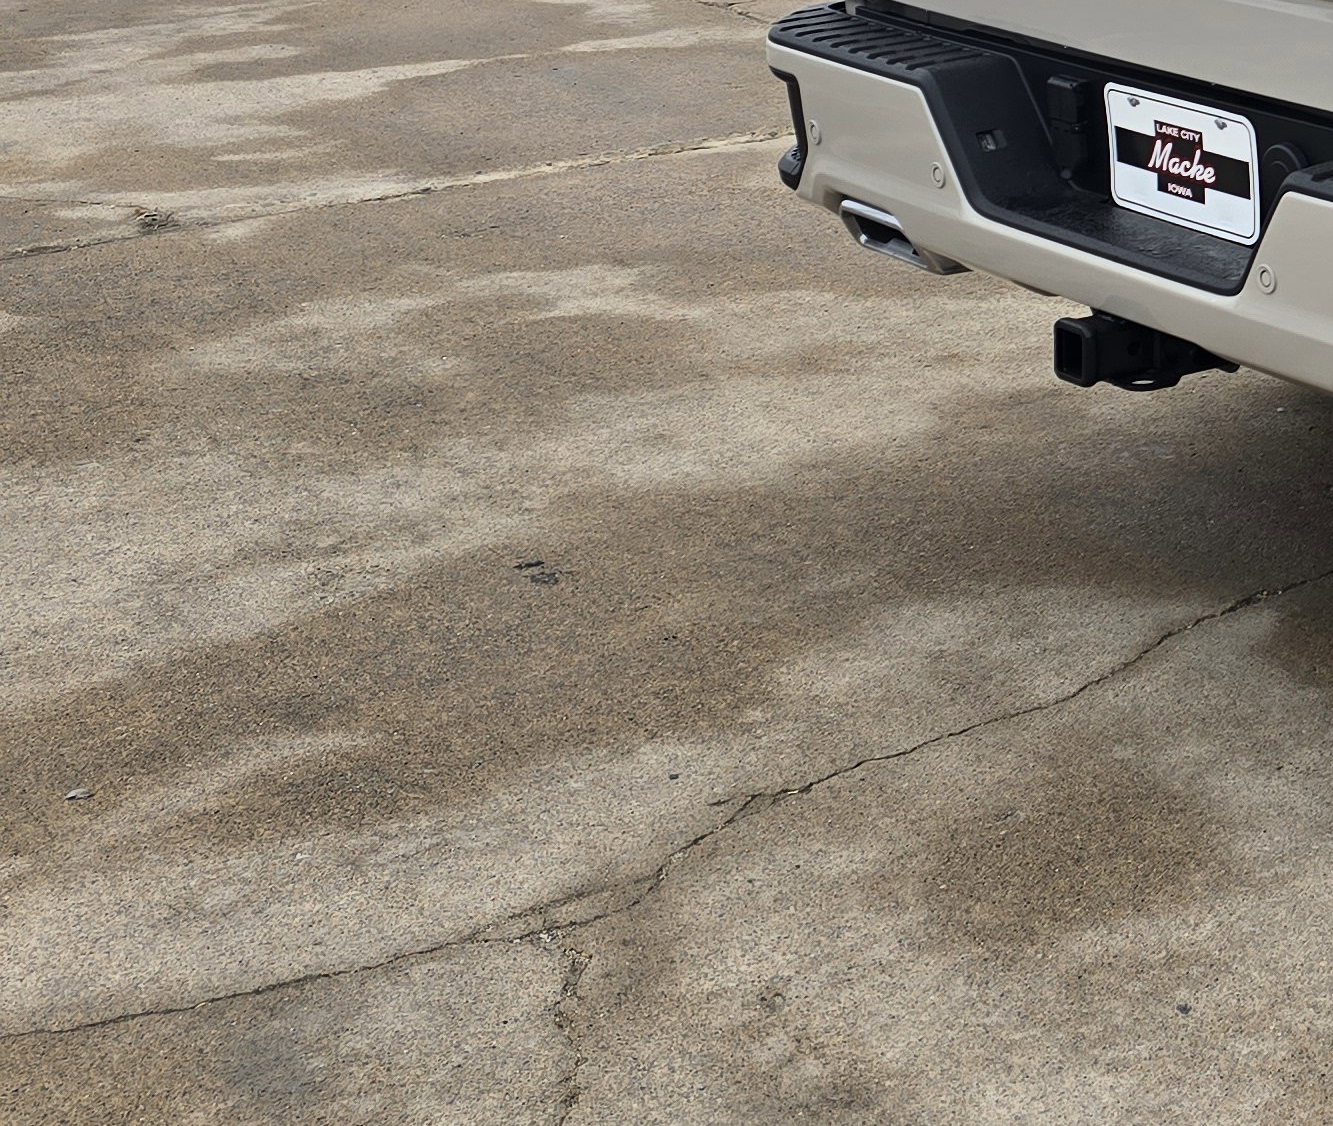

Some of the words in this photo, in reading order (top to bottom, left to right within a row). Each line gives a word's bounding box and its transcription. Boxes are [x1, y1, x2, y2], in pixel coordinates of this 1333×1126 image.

[1156, 124, 1179, 137] LAKE
[1180, 130, 1200, 142] CITY
[1148, 139, 1216, 183] Macke
[1167, 183, 1192, 197] IOWA
